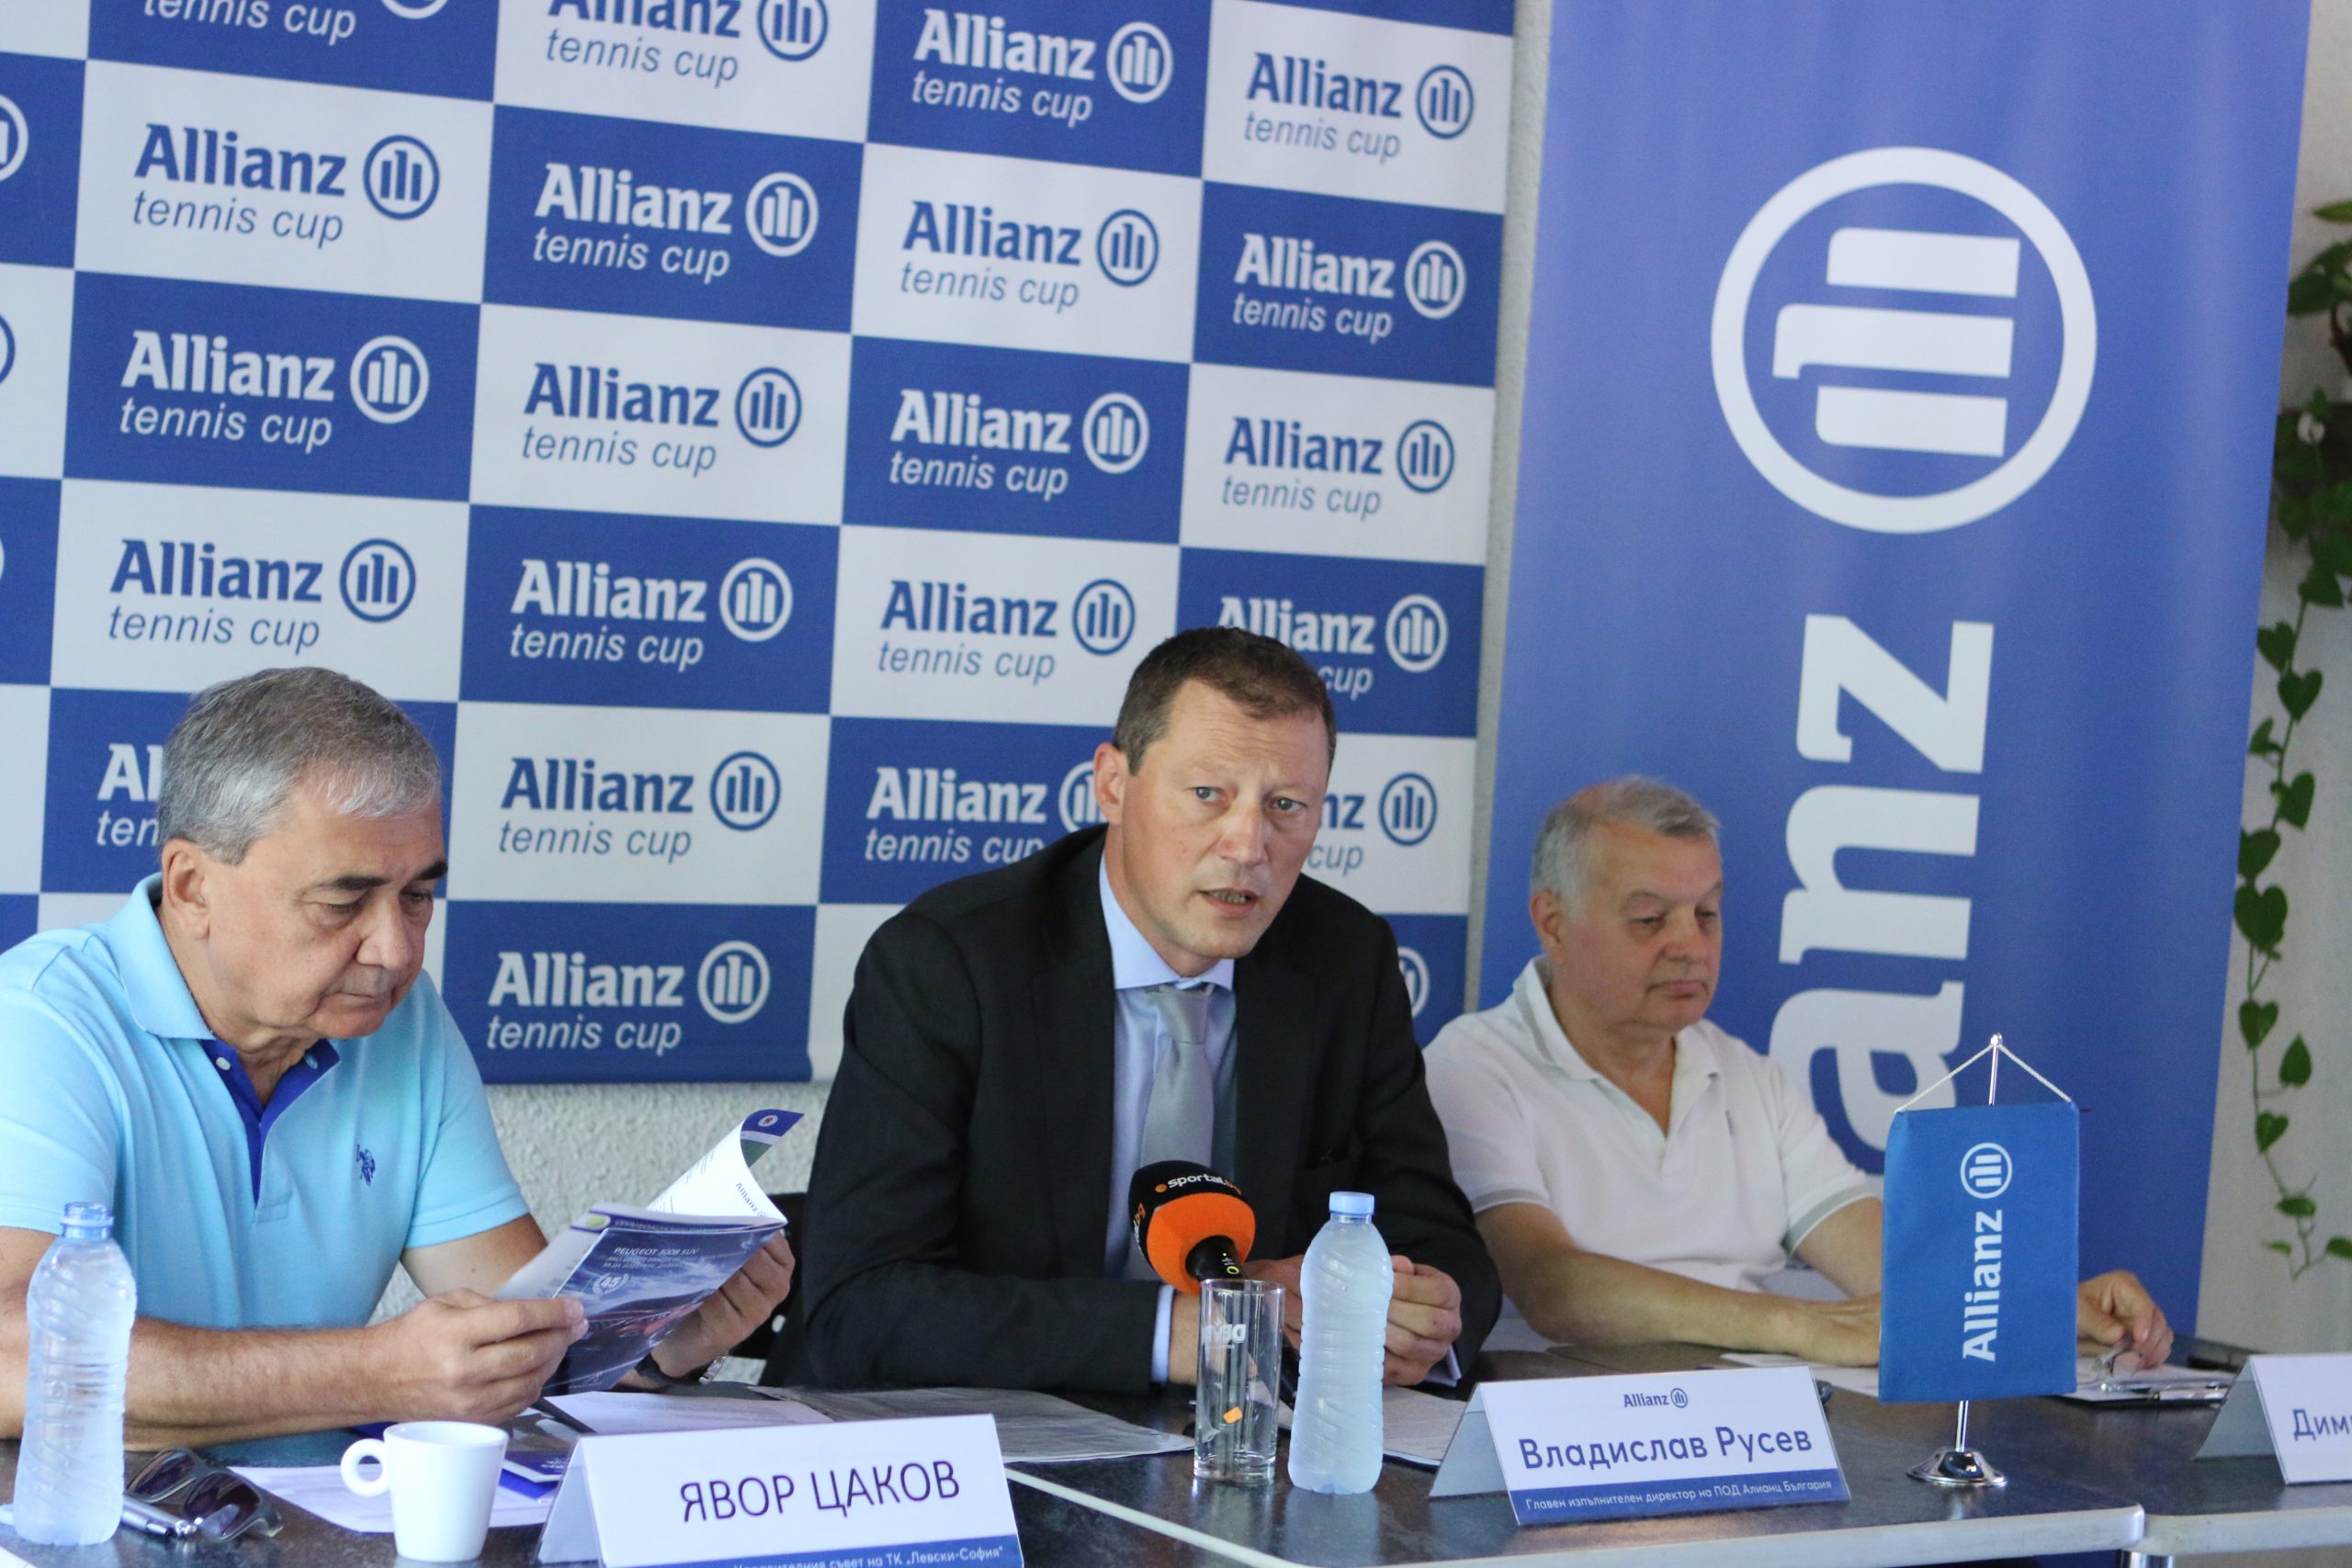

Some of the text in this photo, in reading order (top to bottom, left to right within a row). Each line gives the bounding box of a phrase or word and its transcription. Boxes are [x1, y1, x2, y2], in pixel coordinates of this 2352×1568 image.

[285, 5, 356, 45] cup
[914, 9, 1095, 80] Allianz
[547, 29, 738, 88] tennis cup
[1248, 52, 1402, 118] Allianz
[912, 71, 1092, 128] tennis cup
[135, 124, 345, 197] Allianz
[1245, 112, 1400, 164] tennis cup
[133, 191, 343, 249] tennis cup
[535, 164, 731, 233] Allianz
[534, 227, 729, 284] tennis cup
[903, 201, 1081, 265] Allianz
[901, 263, 1080, 314] tennis cup
[1235, 233, 1395, 299] Allianz
[1233, 293, 1393, 344] tennis cup
[121, 331, 334, 400] Allianz
[525, 363, 719, 427] Allianz
[891, 389, 1071, 453] Allianz
[120, 398, 332, 454] tennis cup
[523, 426, 716, 478] tennis cup
[1225, 417, 1383, 475] Allianz
[889, 451, 1068, 502] tennis cup
[1222, 476, 1382, 521] tennis cup
[110, 539, 322, 602] Allianz
[512, 559, 707, 622] Allianz
[109, 606, 320, 655] tennis cup
[881, 581, 1057, 637] Allianz
[511, 624, 703, 671] tennis cup
[878, 641, 1055, 686] tennis cup
[502, 758, 694, 813] Allianz
[866, 767, 1046, 823] Allianz
[96, 810, 160, 847] ten
[500, 821, 691, 864] tennis cup
[865, 829, 971, 863] tennis
[1307, 842, 1364, 874] cup
[489, 953, 684, 1006] Allianz
[487, 1014, 681, 1056] tennis cup
[1963, 1210, 2002, 1361] Allianz
[1624, 1393, 1668, 1407] Allianz
[2293, 1409, 2352, 1441] Дим
[1519, 1427, 1812, 1470] Владислав Русев
[681, 1461, 959, 1522] ЯВОР ЦАКОВ
[1526, 1480, 1832, 1511] Главен изпълнителен директор на ПОД Алианц България
[867, 1557, 883, 1567] на
[886, 1553, 902, 1566] ТК
